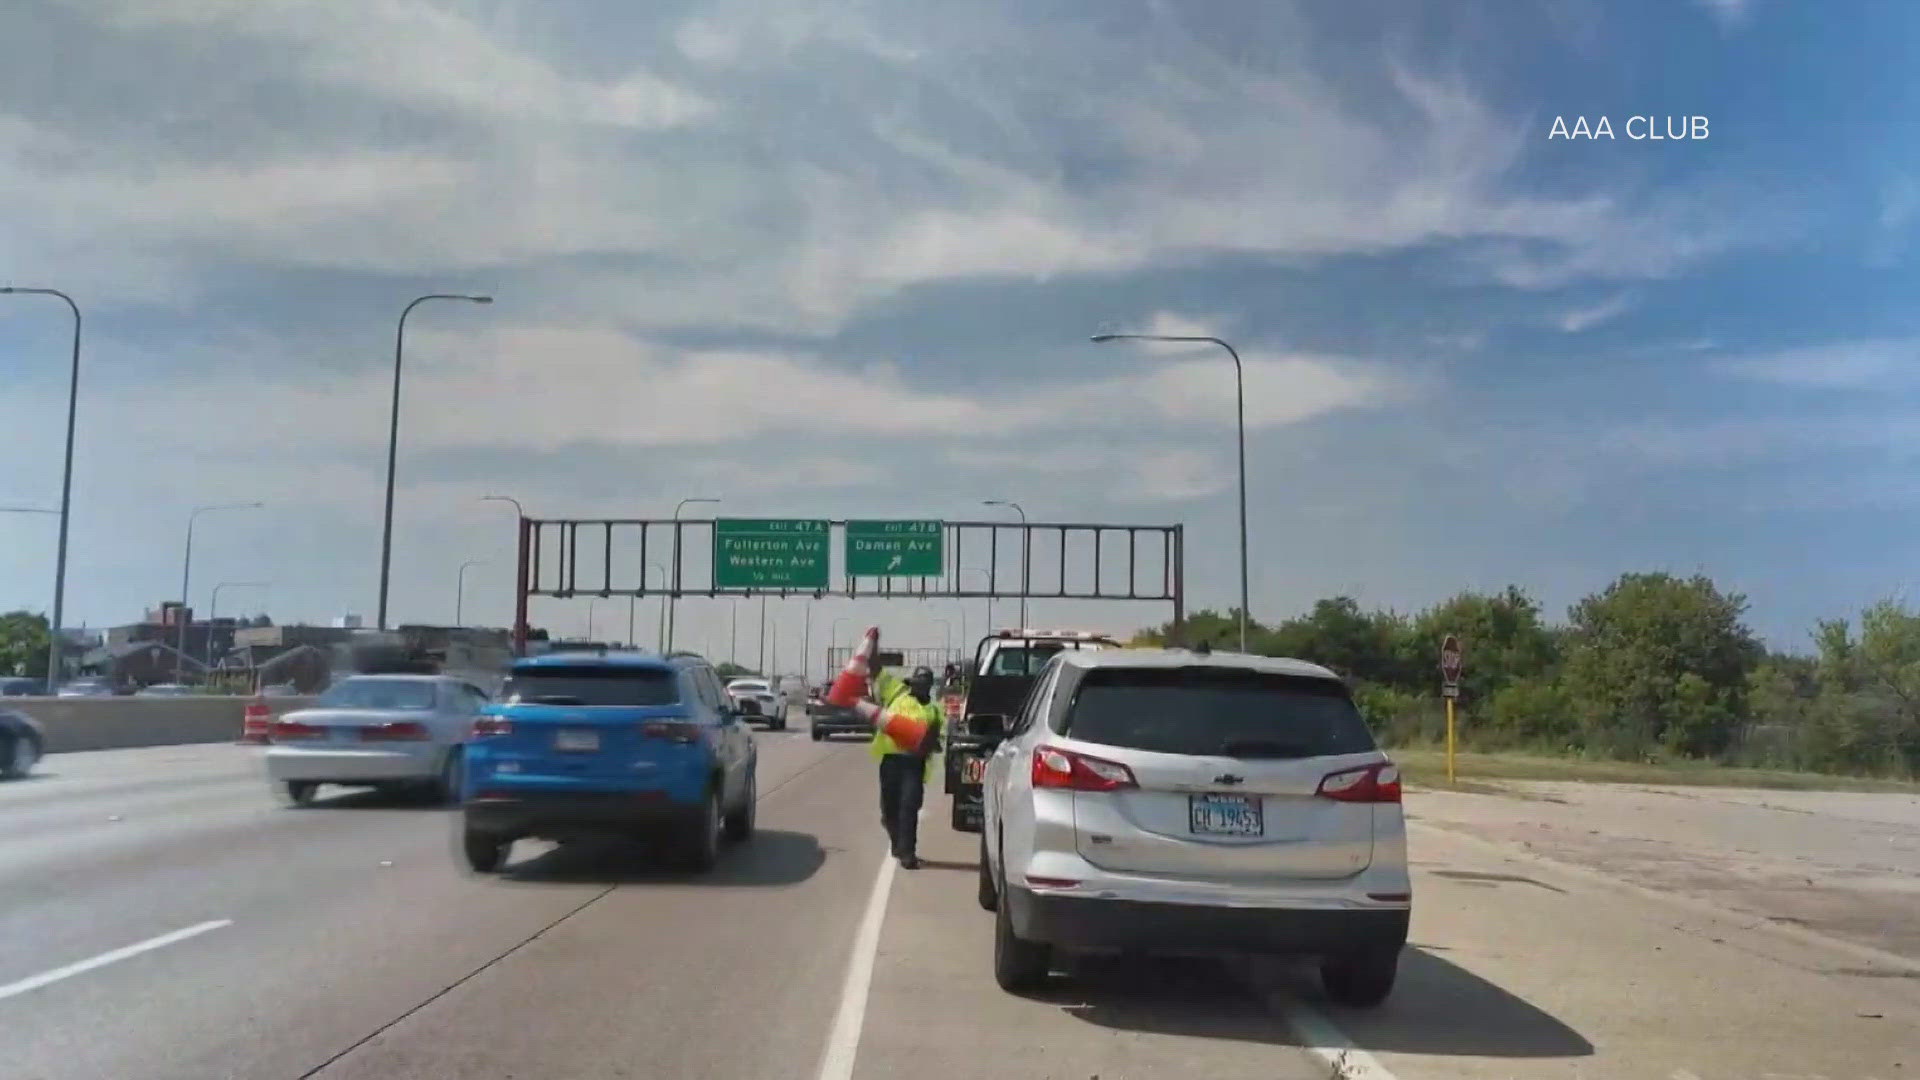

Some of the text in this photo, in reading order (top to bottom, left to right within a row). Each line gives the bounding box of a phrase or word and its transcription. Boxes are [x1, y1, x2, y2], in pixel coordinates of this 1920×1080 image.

[725, 539, 820, 551] Fullerton Ave
[856, 539, 932, 551] Damen Ave
[729, 555, 816, 566] Western Ave
